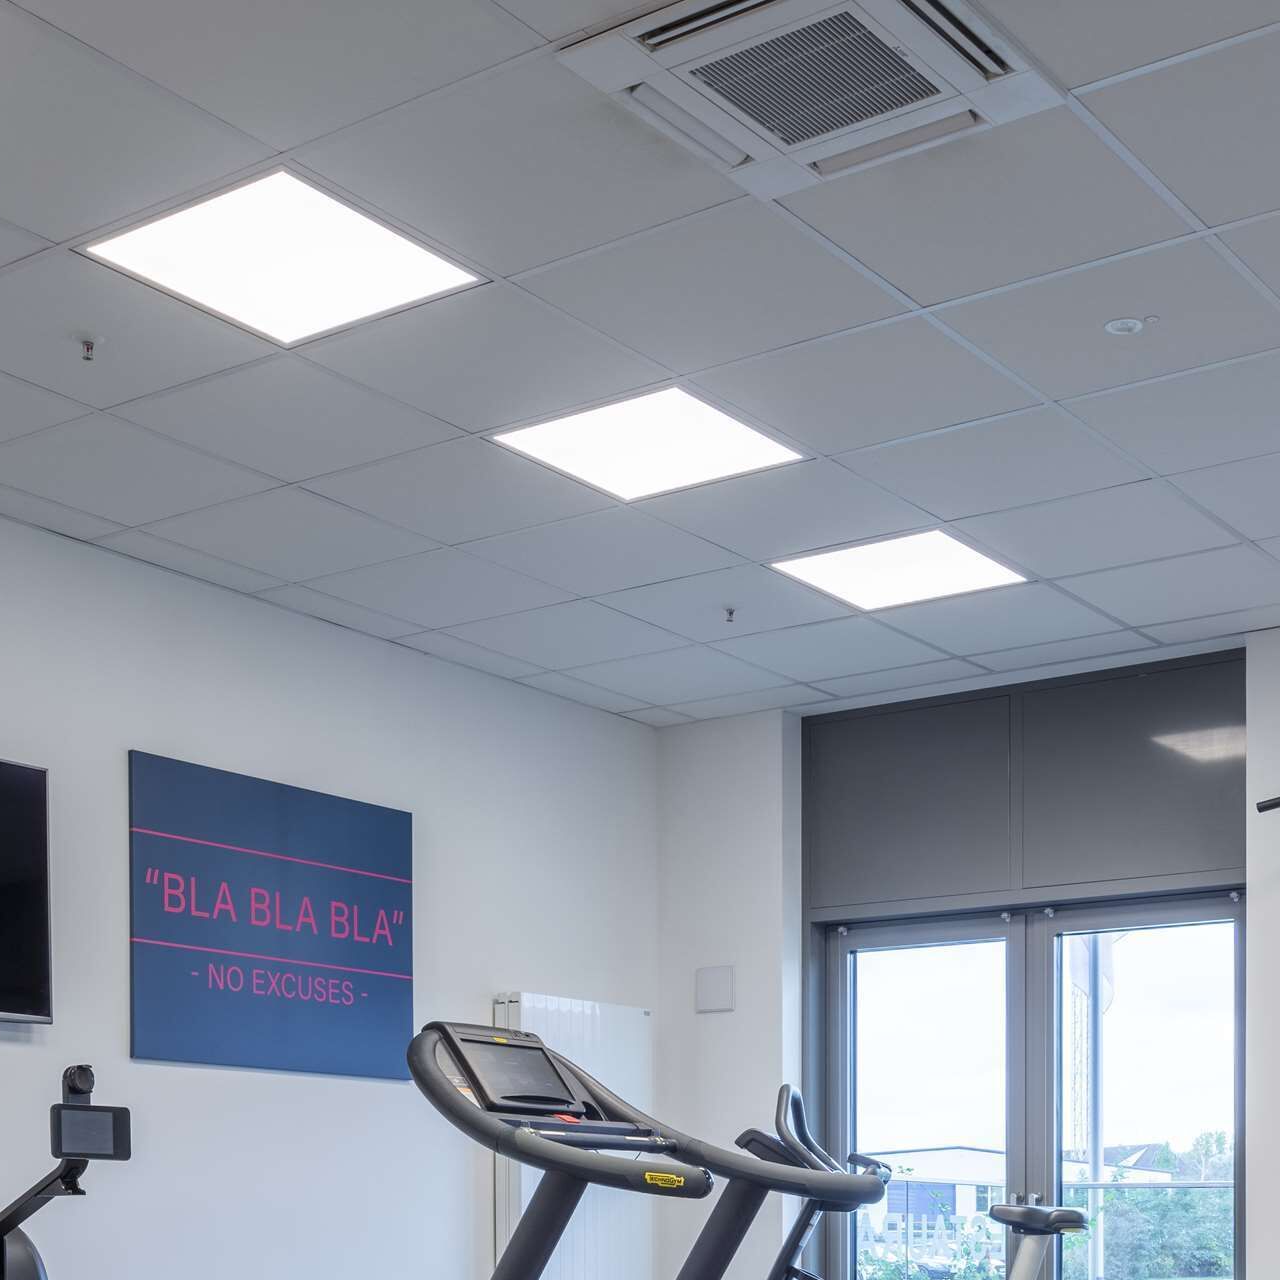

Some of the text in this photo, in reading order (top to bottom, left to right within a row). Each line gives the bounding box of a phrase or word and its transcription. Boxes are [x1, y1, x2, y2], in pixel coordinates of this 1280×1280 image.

[249, 887, 318, 934] BLA
[207, 963, 244, 992] NO
[252, 969, 354, 1005] EXCUSES
